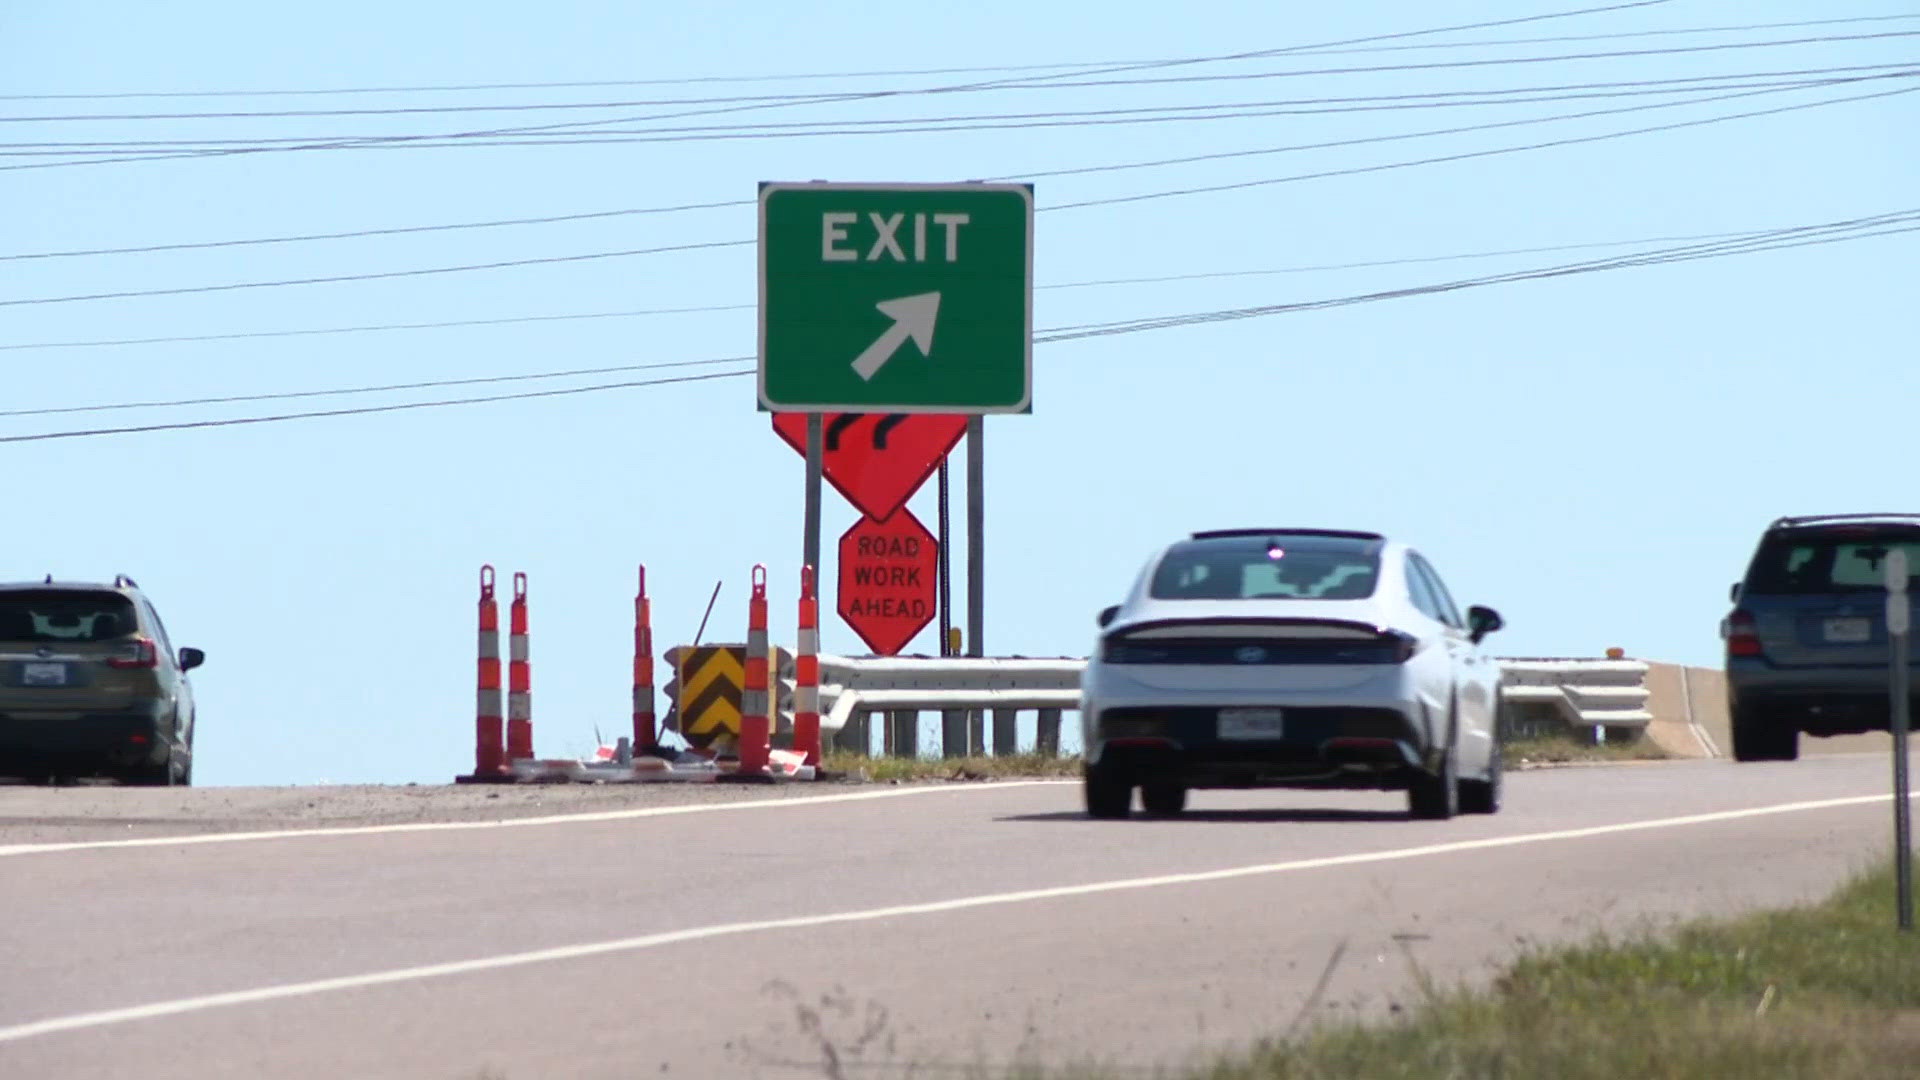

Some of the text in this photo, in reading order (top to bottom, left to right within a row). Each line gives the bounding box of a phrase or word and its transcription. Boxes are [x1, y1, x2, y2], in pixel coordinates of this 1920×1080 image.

[821, 211, 970, 262] EXIT
[857, 535, 919, 557] ROAD
[855, 566, 920, 587] WORK
[849, 598, 926, 618] AHEAD
